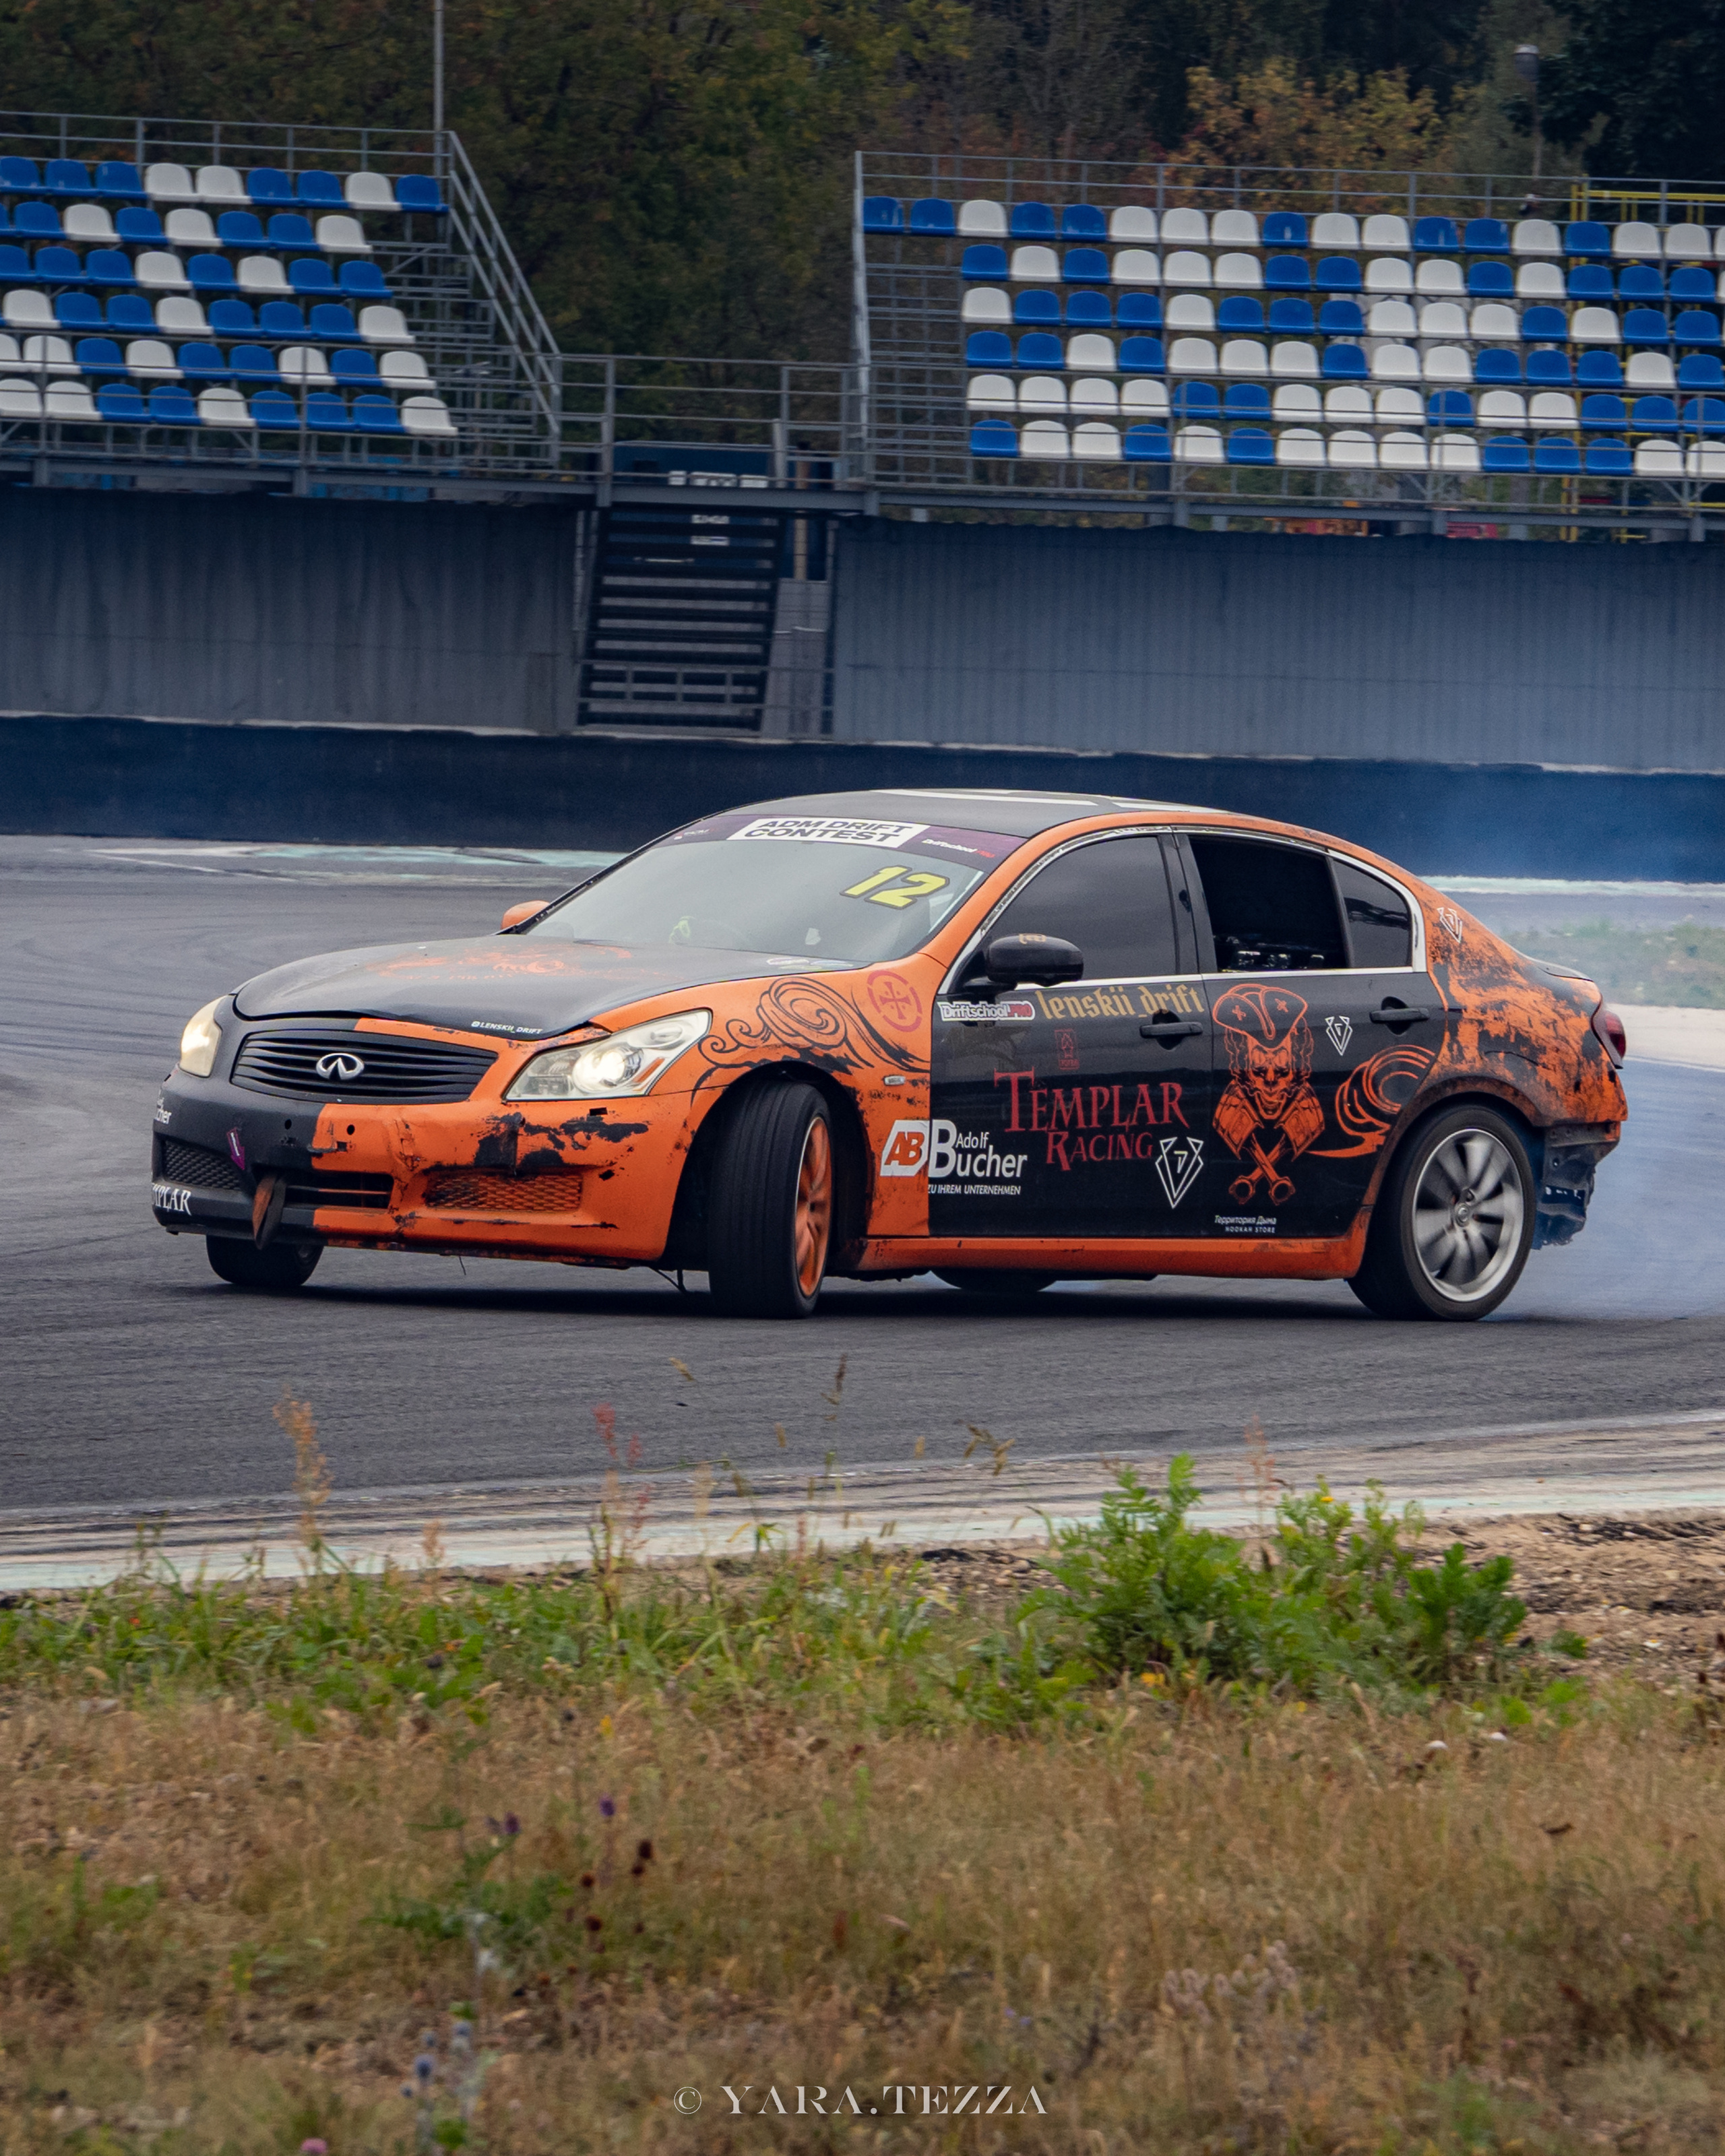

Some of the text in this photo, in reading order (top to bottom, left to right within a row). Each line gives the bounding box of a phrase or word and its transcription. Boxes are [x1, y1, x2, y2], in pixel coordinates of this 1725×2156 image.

[744, 828, 900, 842] CONTEST
[756, 820, 912, 833] ADM DRIFT
[840, 865, 950, 910] 12
[994, 1066, 1190, 1133] TEMPLAR
[928, 1118, 1028, 1178] Bucher
[955, 1131, 990, 1149] Adolf
[1046, 1131, 1153, 1171] RACING
[937, 1184, 962, 1194] IHREM
[964, 1184, 1022, 1195] UNTERNEHMEN
